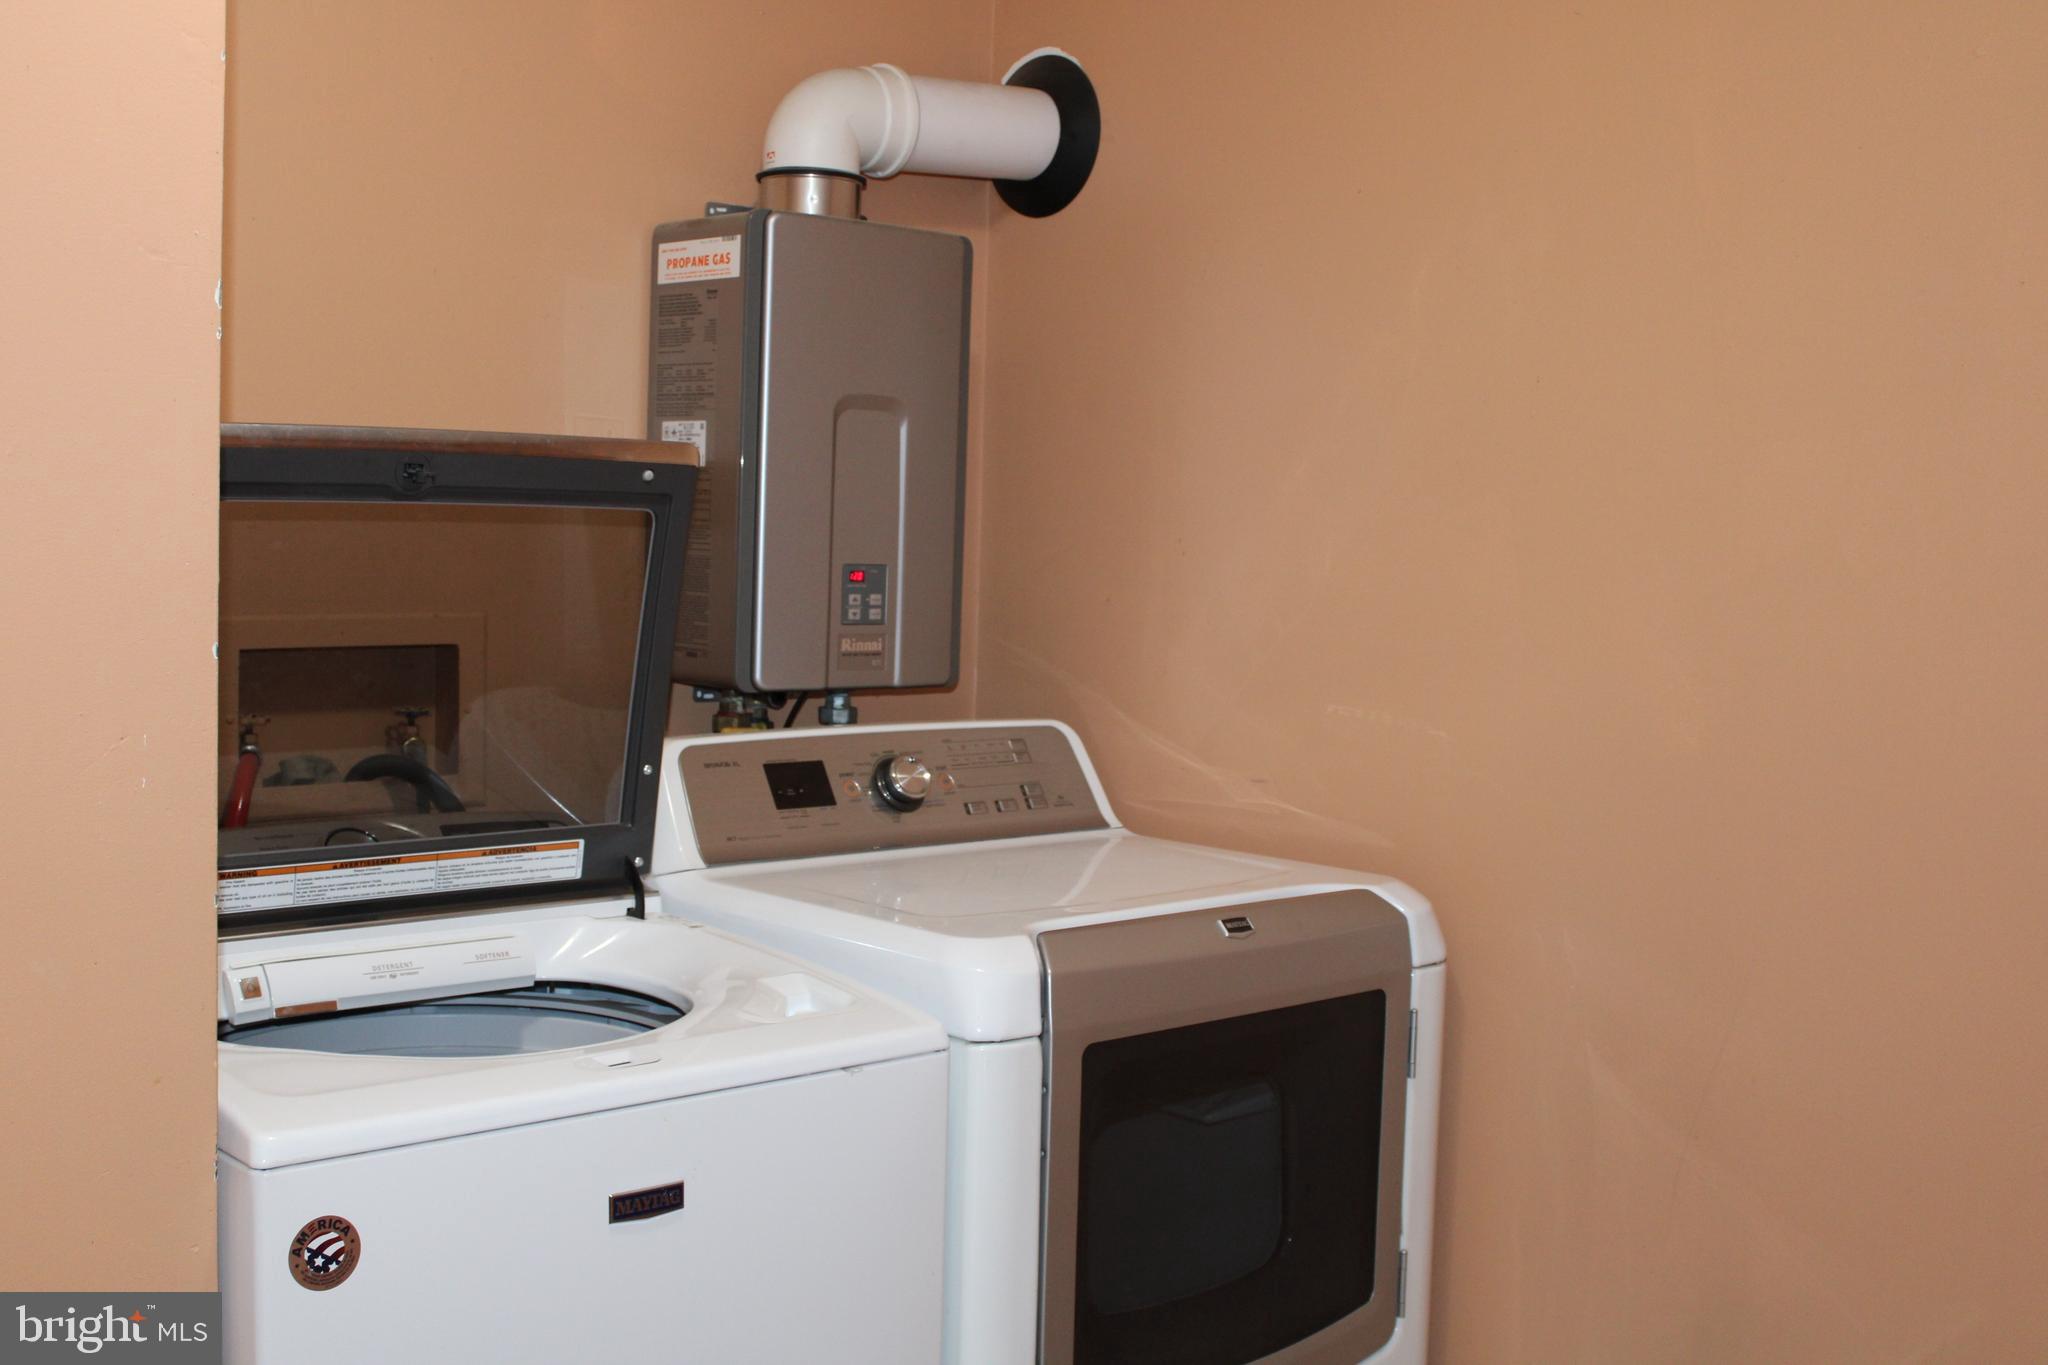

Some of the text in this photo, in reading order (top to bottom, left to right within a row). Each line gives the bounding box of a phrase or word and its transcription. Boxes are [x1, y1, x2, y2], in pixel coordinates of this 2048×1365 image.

[666, 252, 731, 270] PROPANE GAS
[841, 638, 882, 652] Rinnai
[219, 870, 257, 880] WARNING
[474, 951, 511, 961] SOFTENER
[371, 961, 414, 972] DETERGENT
[615, 1188, 681, 1217] MAYTAG
[292, 1218, 351, 1257] AMERICA
